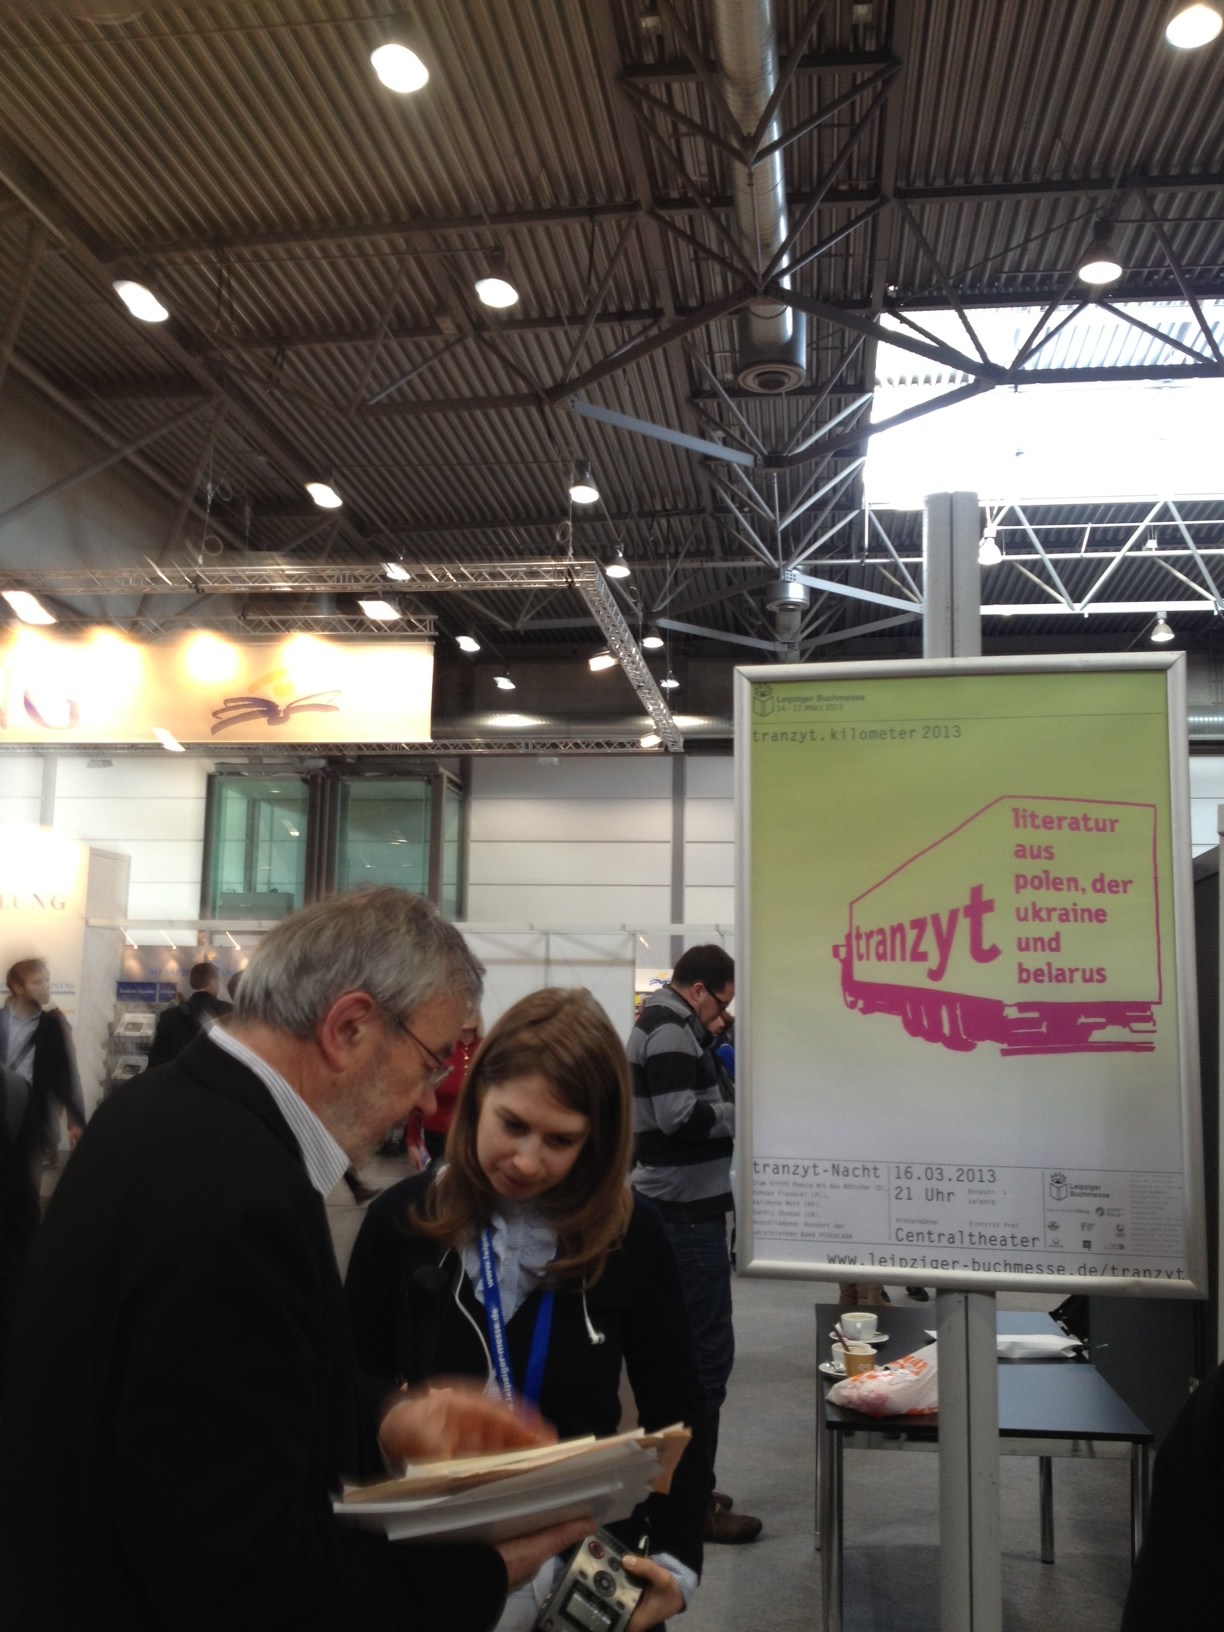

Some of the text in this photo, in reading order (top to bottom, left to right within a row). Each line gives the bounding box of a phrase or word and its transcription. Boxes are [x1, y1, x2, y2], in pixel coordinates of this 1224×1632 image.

[777, 694, 865, 704] Leipziger Buchmesse
[922, 725, 962, 740] 2013
[1013, 808, 1120, 833] literatur
[1013, 842, 1055, 860] aus
[1014, 869, 1133, 895] polen, der
[1015, 901, 1107, 924] ukraine
[855, 883, 1002, 982] tranzyt
[1016, 931, 1061, 953] und
[1017, 962, 1107, 984] belarus
[753, 1160, 881, 1180] tranzyt-Nacht
[894, 1165, 997, 1184] 16.03.2013
[894, 1186, 956, 1202] 21 Uhr
[1069, 1184, 1101, 1192] Leipziger
[895, 1227, 1040, 1248] Centraltheater
[826, 1252, 1185, 1280] www.leipziger-buchmesse.de/tranzyt
